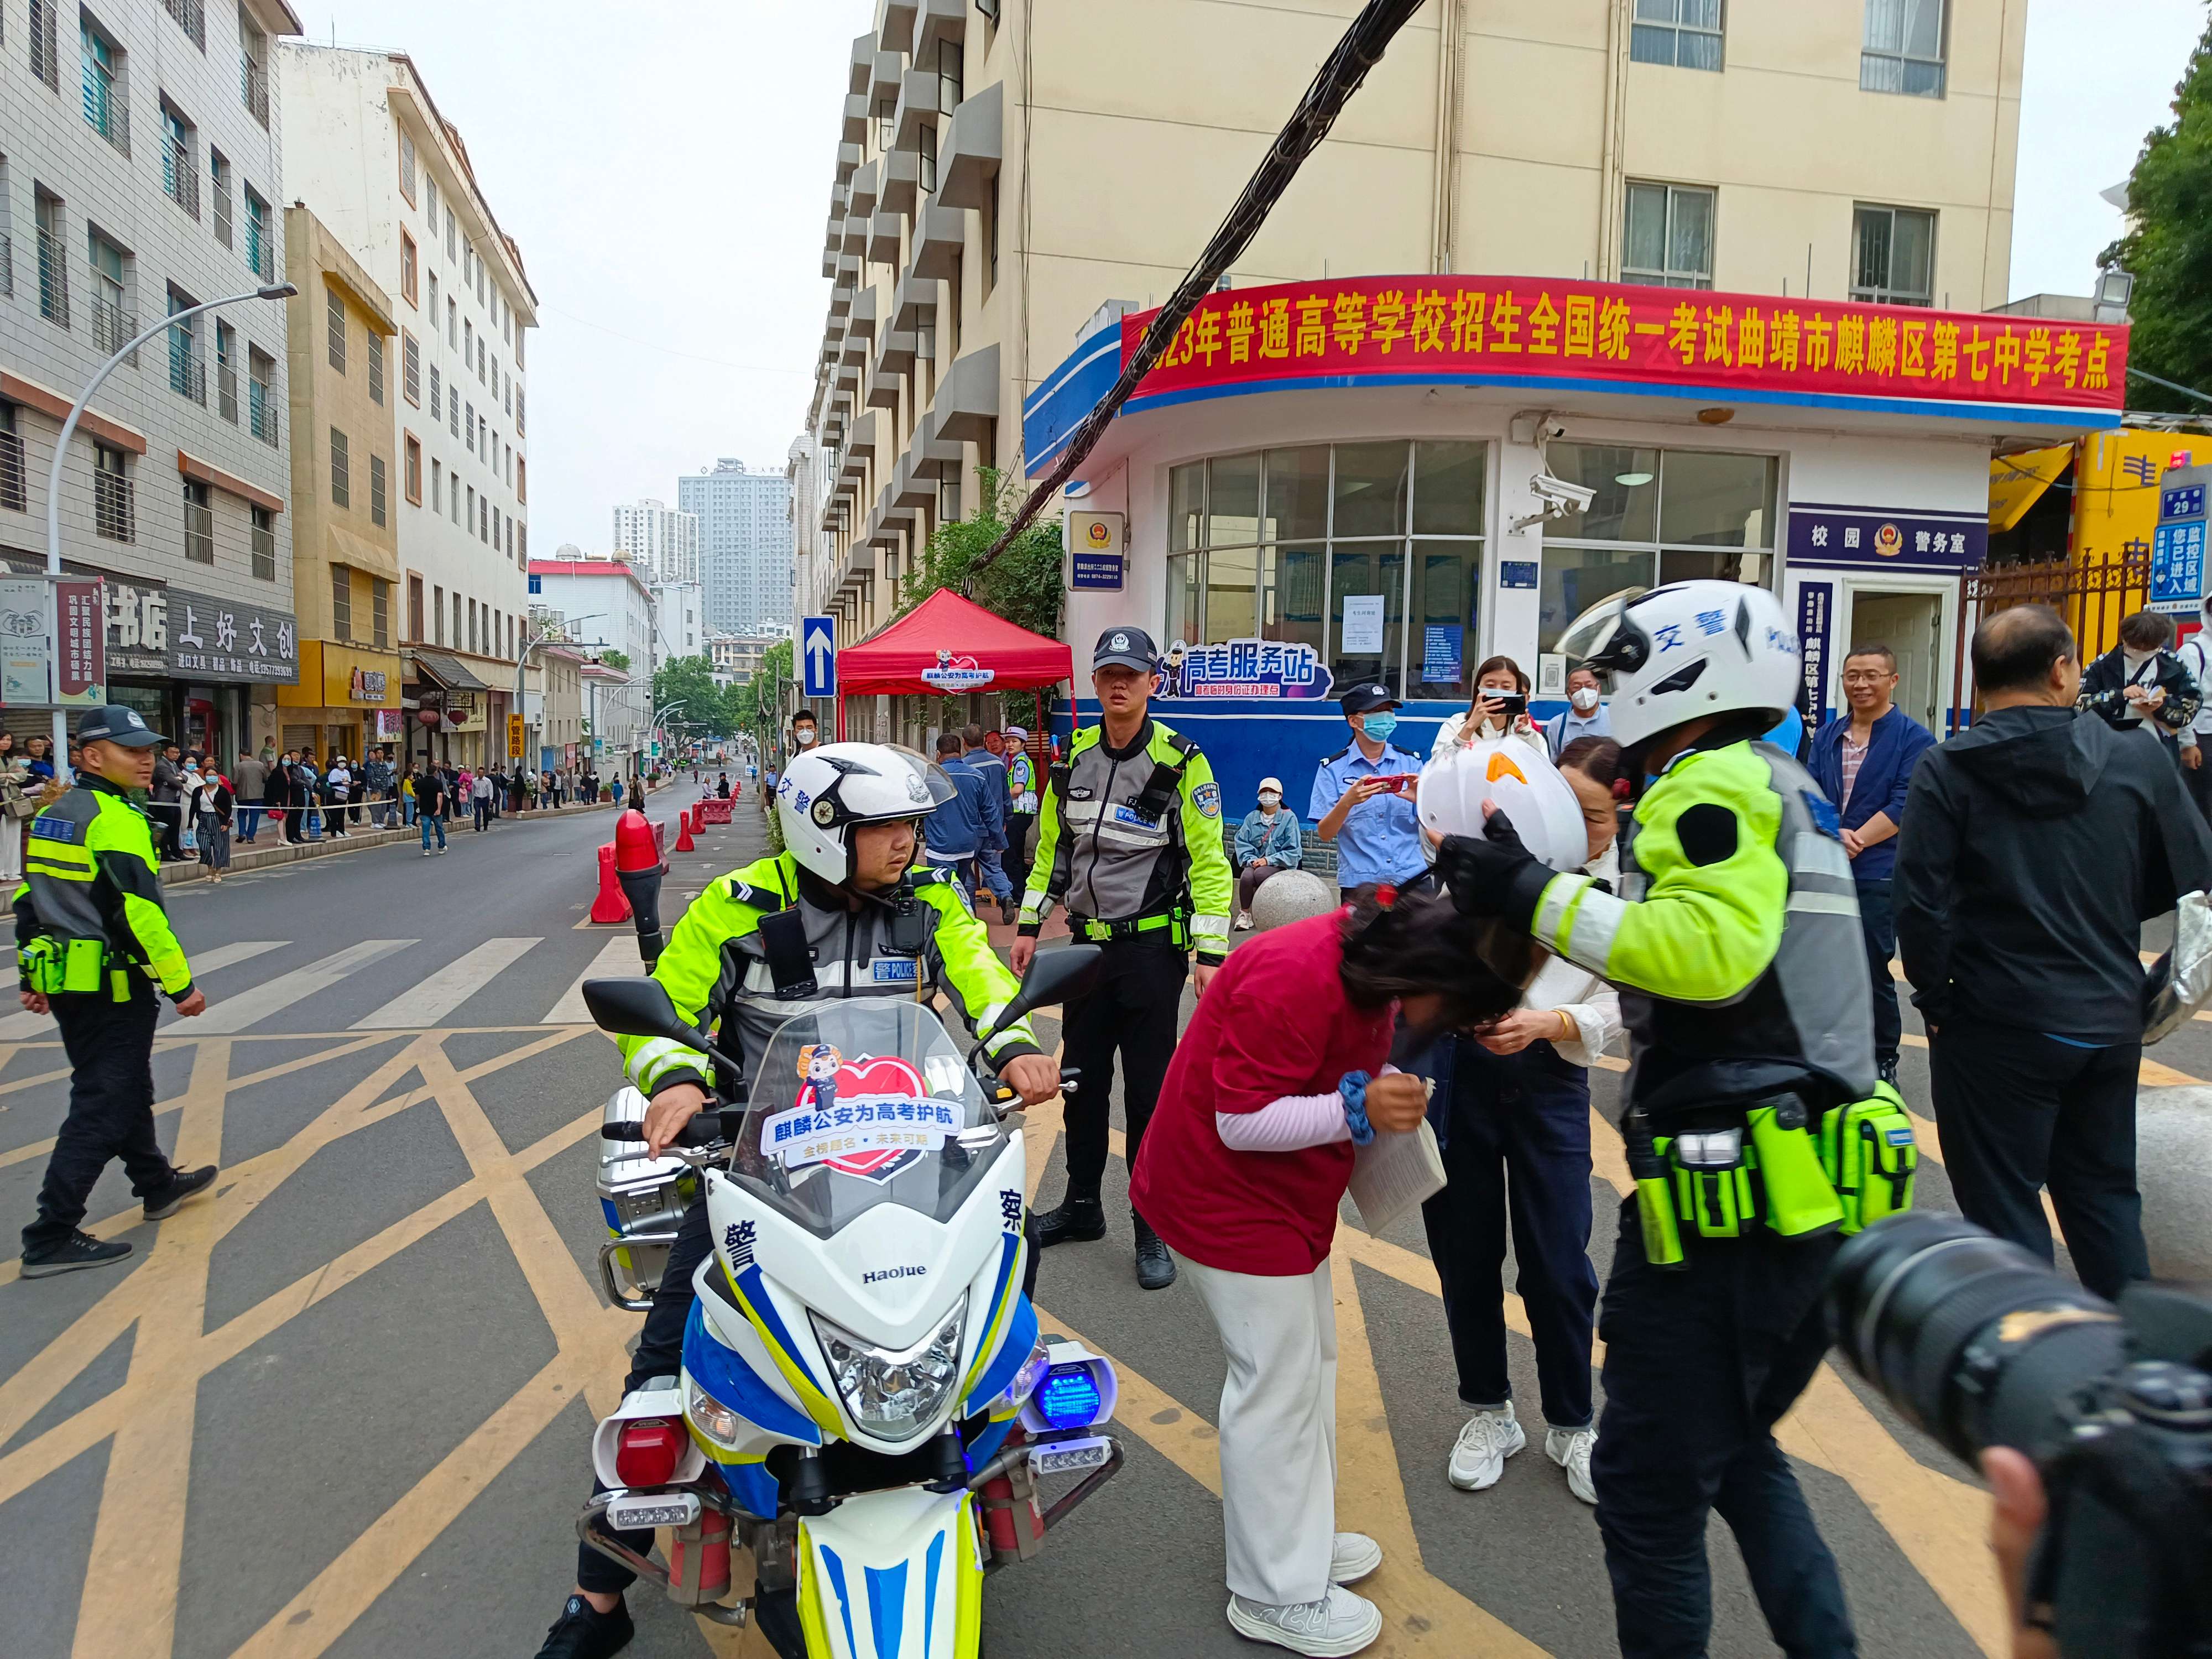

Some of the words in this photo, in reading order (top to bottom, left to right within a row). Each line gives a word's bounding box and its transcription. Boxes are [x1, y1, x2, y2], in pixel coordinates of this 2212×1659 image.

[1140, 288, 2109, 389] 23年普通高等学校招生全国统一考试曲靖市麒麟区第七中学考点
[2173, 500, 2189, 514] 29
[1812, 525, 1860, 548] 校园
[1915, 530, 1965, 554] 警务室
[2169, 528, 2186, 594] 您已进入
[2184, 526, 2201, 593] 监控区域
[103, 583, 167, 651] 书店
[179, 605, 293, 660] 上好文创
[1186, 643, 1313, 691] 高考服务站
[510, 716, 522, 756] 严管路段
[778, 778, 811, 815] 交警
[775, 1103, 953, 1142] 麒麟公安为高考护航
[1000, 1188, 1022, 1233] 察
[724, 1219, 758, 1270] 警
